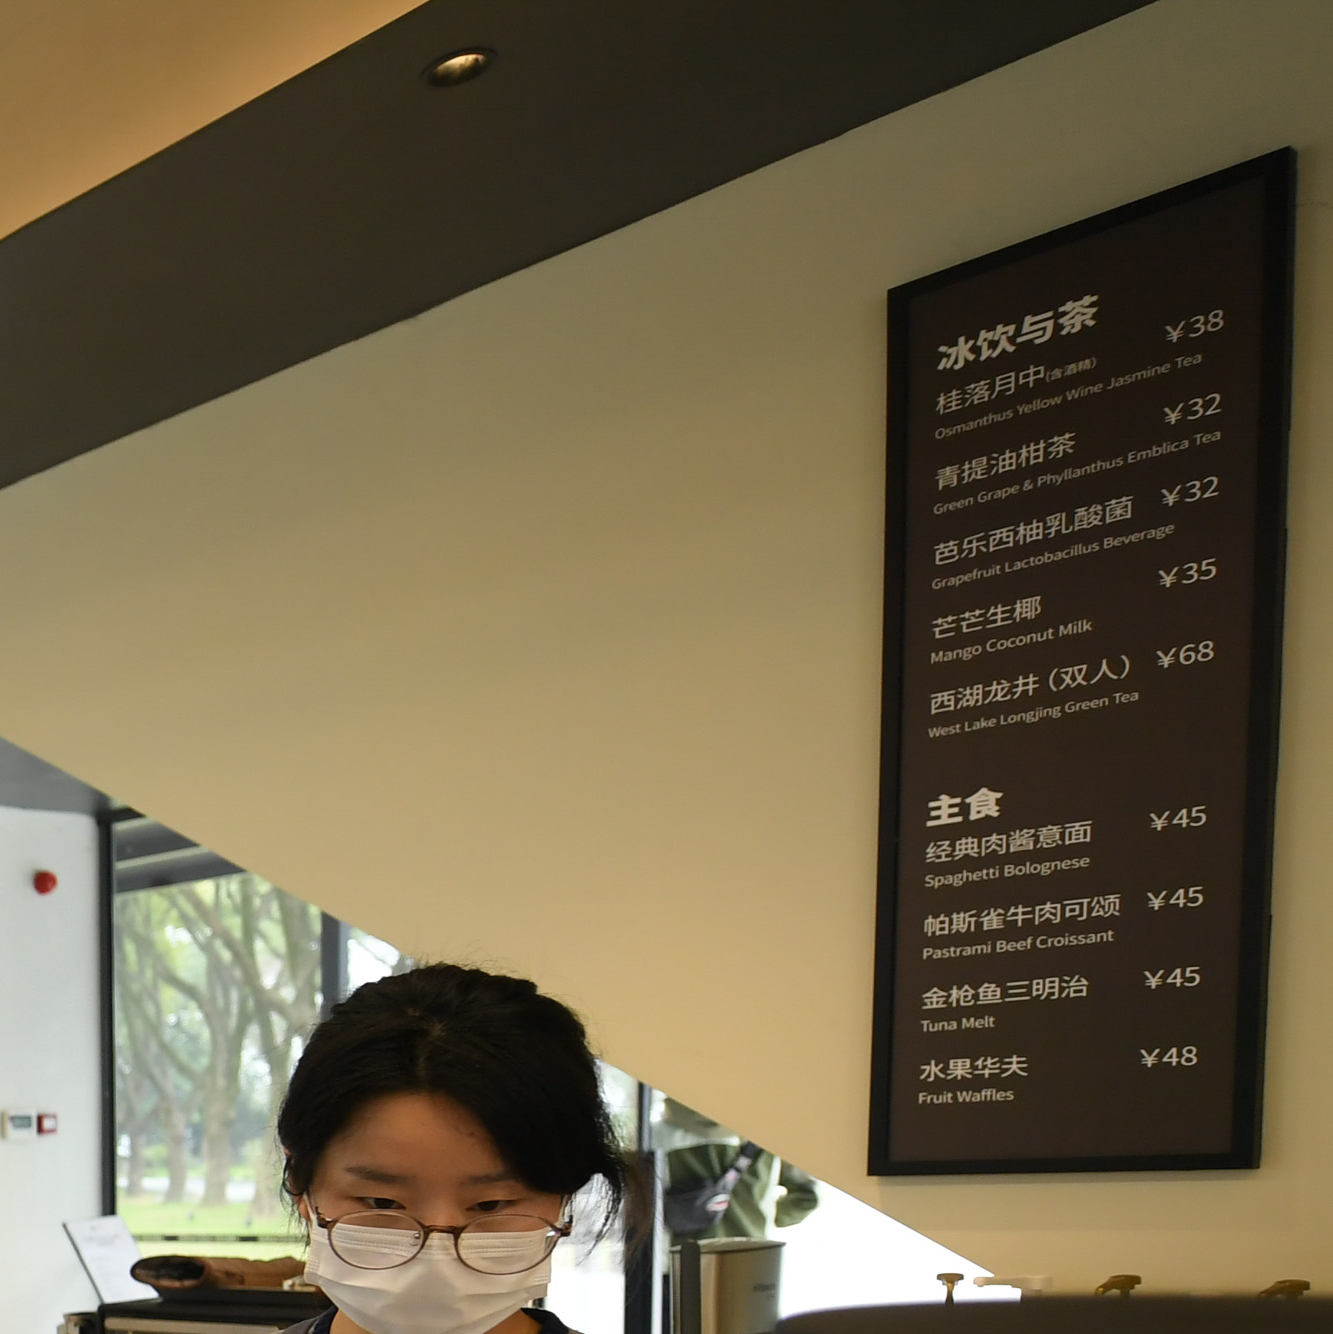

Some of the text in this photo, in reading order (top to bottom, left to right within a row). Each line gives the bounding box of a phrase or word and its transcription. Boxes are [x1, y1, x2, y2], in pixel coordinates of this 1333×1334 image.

[937, 295, 1099, 372] 冰饮与茶
[1165, 310, 1225, 343] ¥38
[935, 353, 1203, 439] Osmanthus Yellow Wine Jasmine Tea
[1163, 393, 1222, 425] ¥32
[933, 429, 1222, 515] Green Grape & Phyllanthus Emblica Tea
[935, 432, 1076, 490] 青提油柑茶
[1161, 476, 1220, 507] ¥32
[933, 495, 1134, 565] 芭乐西柚乳酸菌
[931, 523, 1175, 590] Grapefruit Lactobacillus Beverage
[1158, 558, 1218, 589] ¥35
[932, 595, 1042, 639] 芒芒生椰
[930, 619, 1093, 664] Mango Coconut Milk
[1156, 640, 1215, 669] ¥68
[928, 690, 1139, 738] West Lake Longjing Green Tea
[925, 786, 1004, 827] 主食
[1149, 805, 1207, 831] ¥45
[925, 820, 1093, 864] 经典肉酱意面
[924, 855, 1090, 889] Spaghetti Bolognese
[923, 894, 1121, 937] 帕斯雀牛肉可颂
[1146, 886, 1204, 911] ¥45
[922, 929, 1114, 960] Pastrami Beef Croissant
[921, 974, 1089, 1011] 金枪鱼三明治
[1143, 966, 1201, 990] ¥45
[921, 1015, 995, 1033] Tuna Melt
[919, 1054, 1028, 1082] 水果华夫
[1140, 1046, 1198, 1068] ¥48
[918, 1087, 1015, 1105] Fruit Waffles
